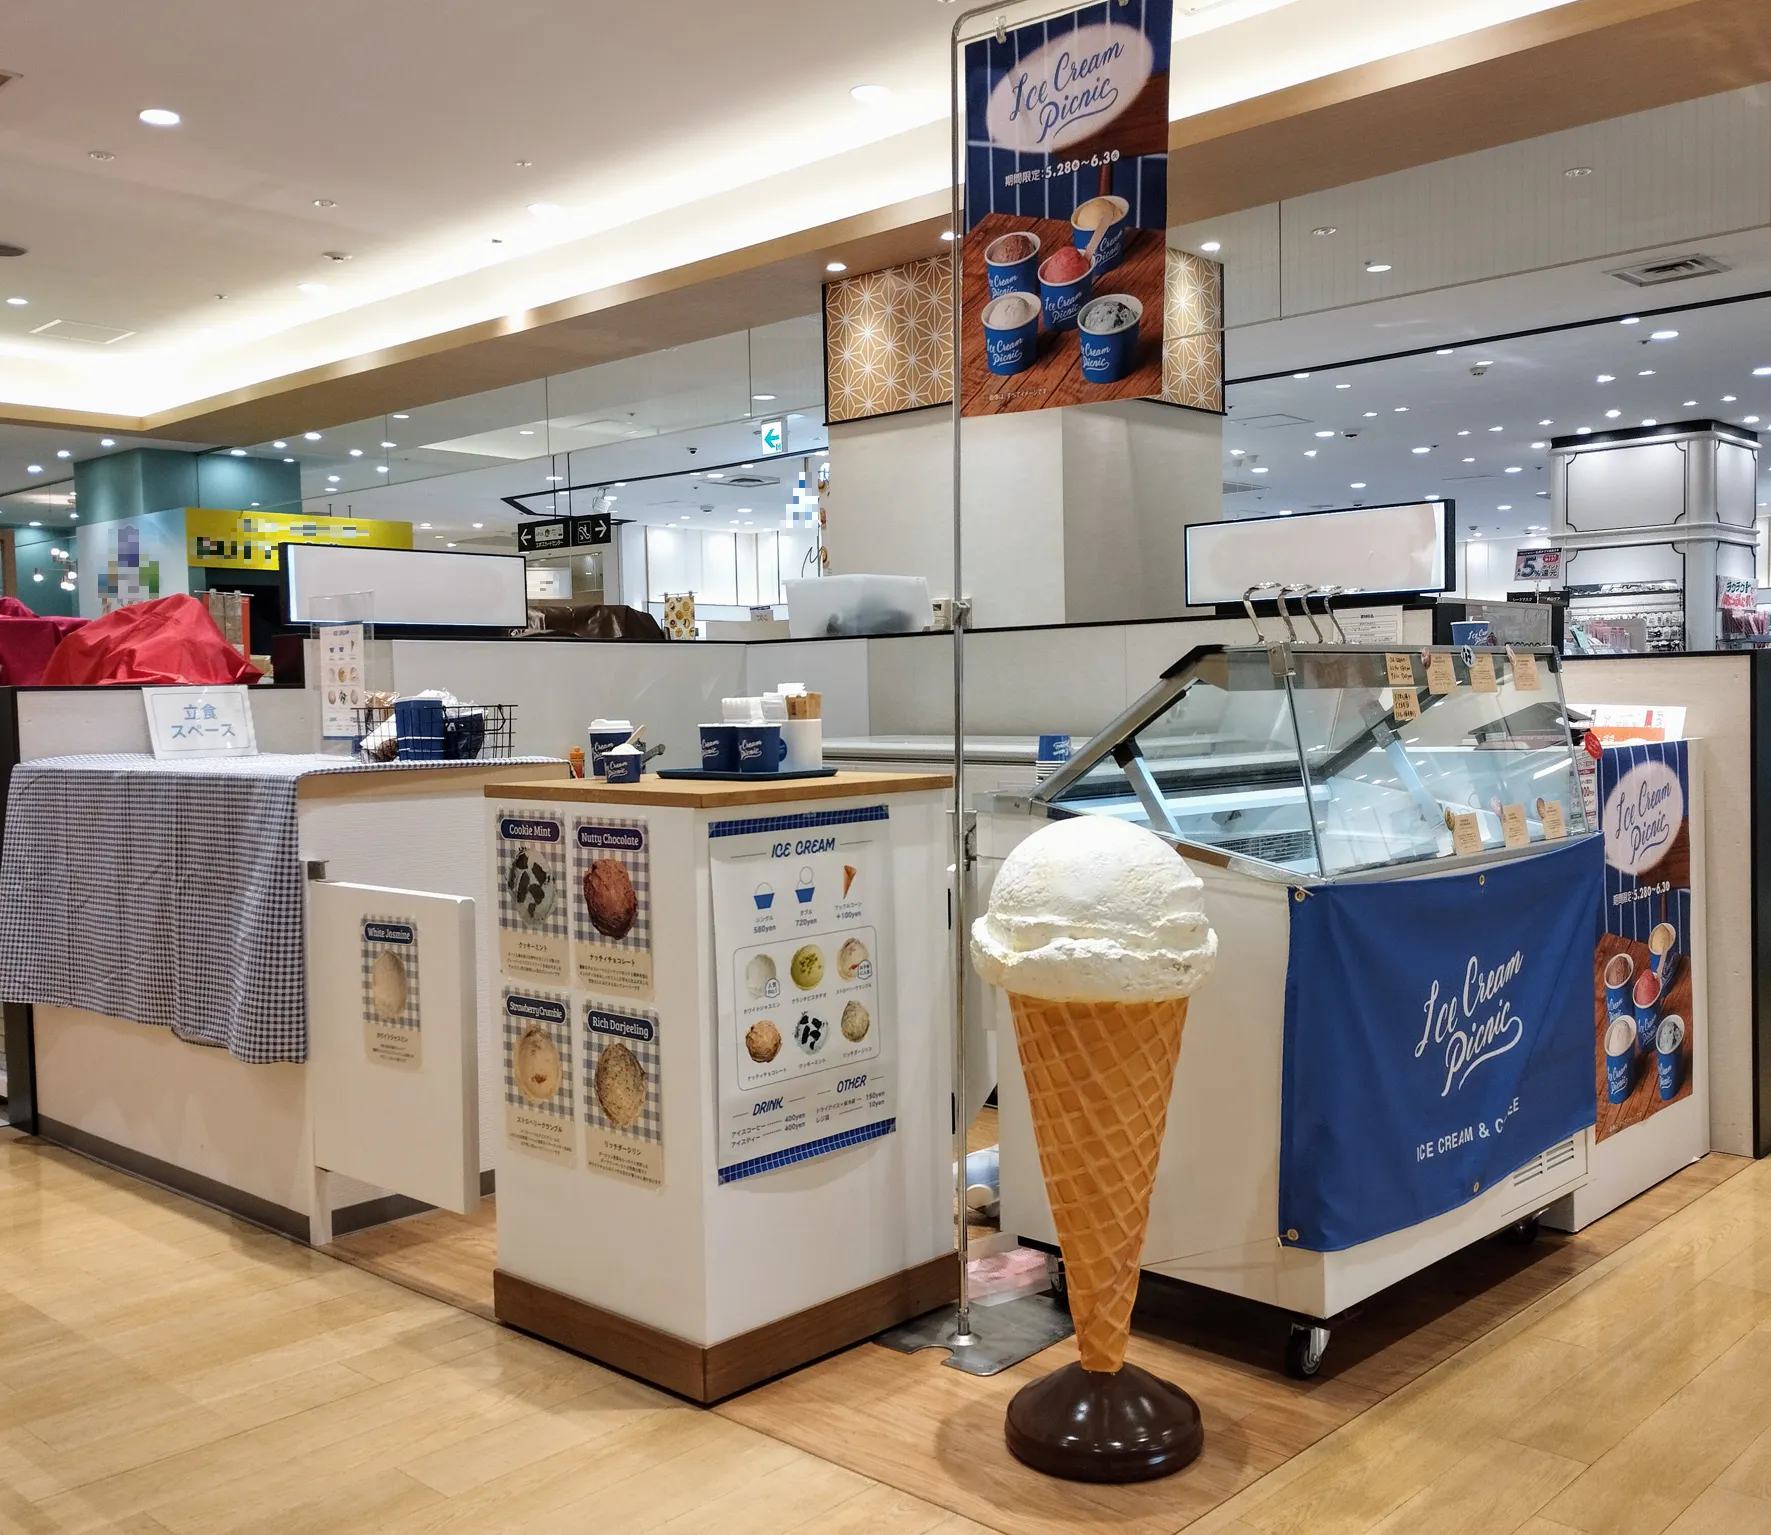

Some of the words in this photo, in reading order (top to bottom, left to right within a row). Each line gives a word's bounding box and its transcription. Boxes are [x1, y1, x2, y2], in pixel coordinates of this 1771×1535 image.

[1009, 71, 1049, 121] Ice
[1054, 41, 1125, 92] Cream
[1036, 77, 1119, 143] Picnic
[1045, 296, 1056, 312] Ice
[1057, 291, 1083, 310] Cream
[1052, 303, 1082, 324] Picnic
[996, 337, 1024, 353] Cream
[1085, 342, 1111, 357] Cream
[992, 349, 1023, 367] Picnic
[1082, 356, 1110, 371] Picnic
[183, 703, 217, 720] 立食
[171, 723, 236, 739] スペース
[1615, 792, 1635, 840] Ice
[1638, 780, 1672, 818] Cream
[509, 823, 532, 836] Cookie
[533, 825, 551, 838] Mint
[581, 832, 602, 846] Nutty
[603, 834, 639, 847] Chocolate
[1630, 810, 1670, 865] Picnic
[771, 843, 792, 858] ICE
[795, 837, 836, 856] CREAM
[795, 918, 817, 927] 720yen
[367, 927, 385, 938] White
[385, 928, 411, 940] Jasmine
[1414, 979, 1459, 1058] Ice
[1463, 949, 1524, 1018] Cream
[592, 1016, 609, 1030] Rich
[610, 1019, 649, 1039] Darjeeling
[1441, 998, 1523, 1097] Picnic
[836, 1074, 867, 1094] OTHER
[752, 1096, 784, 1116] DRINK
[731, 1123, 766, 1139] アイスコーヒー
[784, 1112, 806, 1123] 400yen
[731, 1135, 761, 1148] アイスティー
[784, 1121, 806, 1132] 400yen
[604, 1140, 642, 1157] リッチダージリン
[1416, 1141, 1434, 1163] ICE
[1438, 1126, 1474, 1155] CREAM
[1478, 1122, 1490, 1139] &
